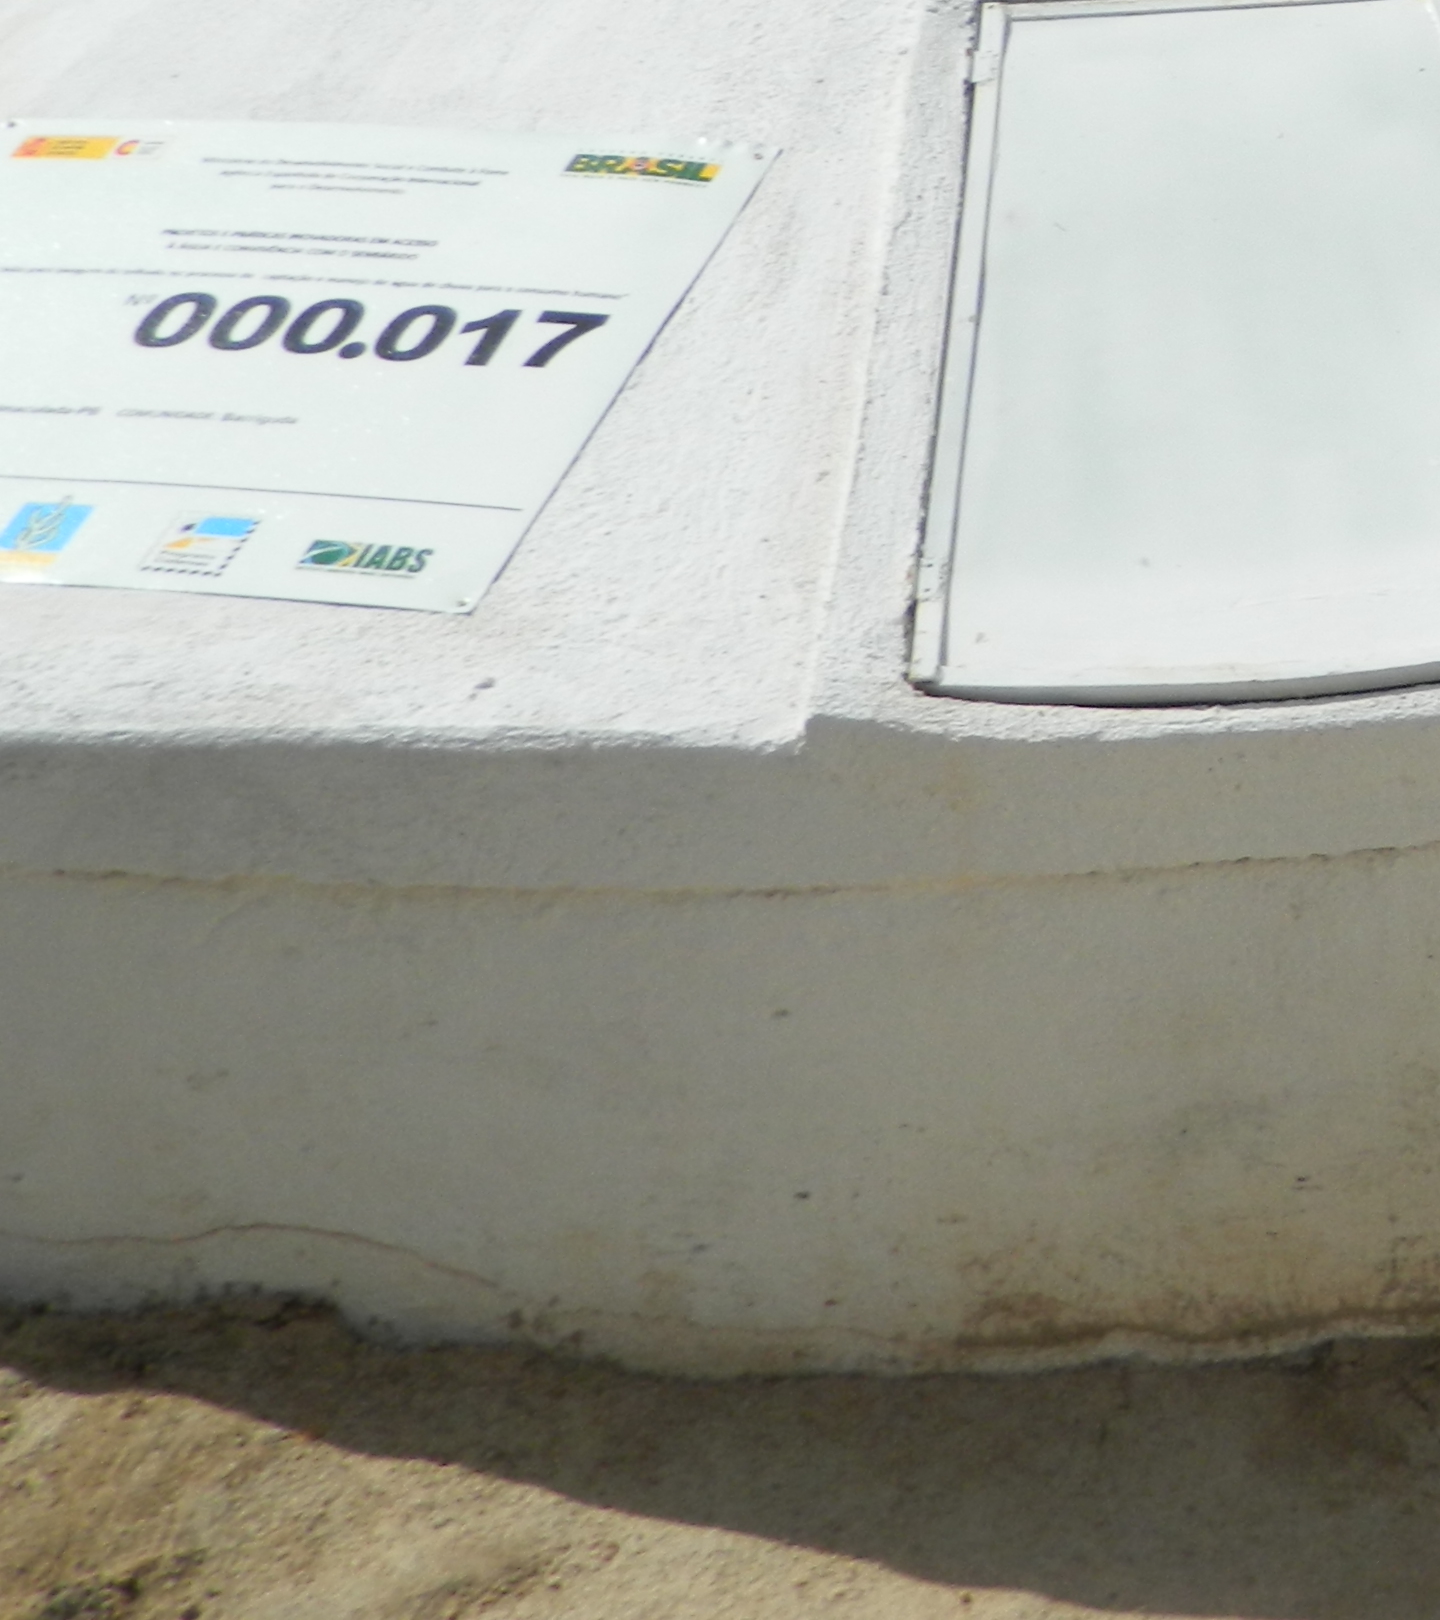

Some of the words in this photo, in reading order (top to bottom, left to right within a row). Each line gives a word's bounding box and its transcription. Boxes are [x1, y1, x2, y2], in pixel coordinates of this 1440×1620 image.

[564, 153, 714, 182] BRASIL
[133, 291, 610, 369] 000.017
[353, 543, 434, 574] IABS
